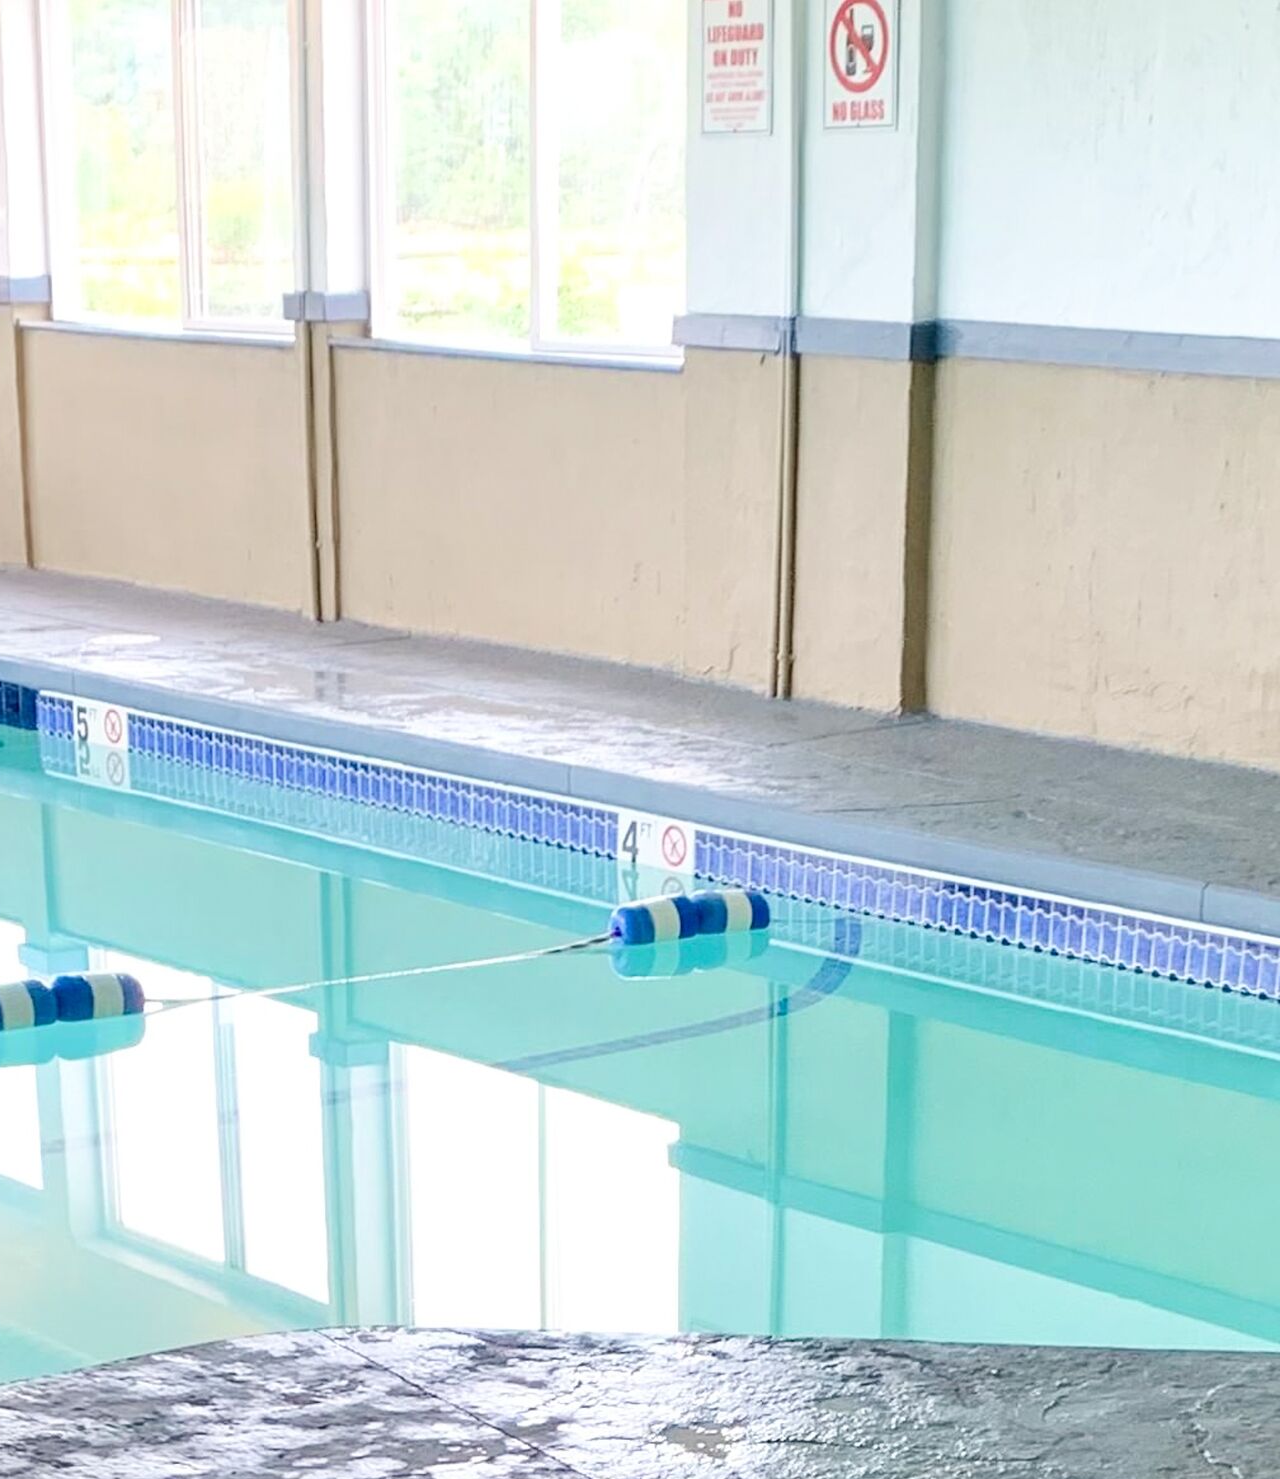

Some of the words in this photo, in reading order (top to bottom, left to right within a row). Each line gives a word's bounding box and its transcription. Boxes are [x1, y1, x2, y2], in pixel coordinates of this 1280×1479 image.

[730, 47, 758, 66] DUTY
[832, 102, 847, 121] NO
[850, 99, 885, 120] GLASS
[77, 706, 89, 742] 5
[622, 821, 639, 863] 4
